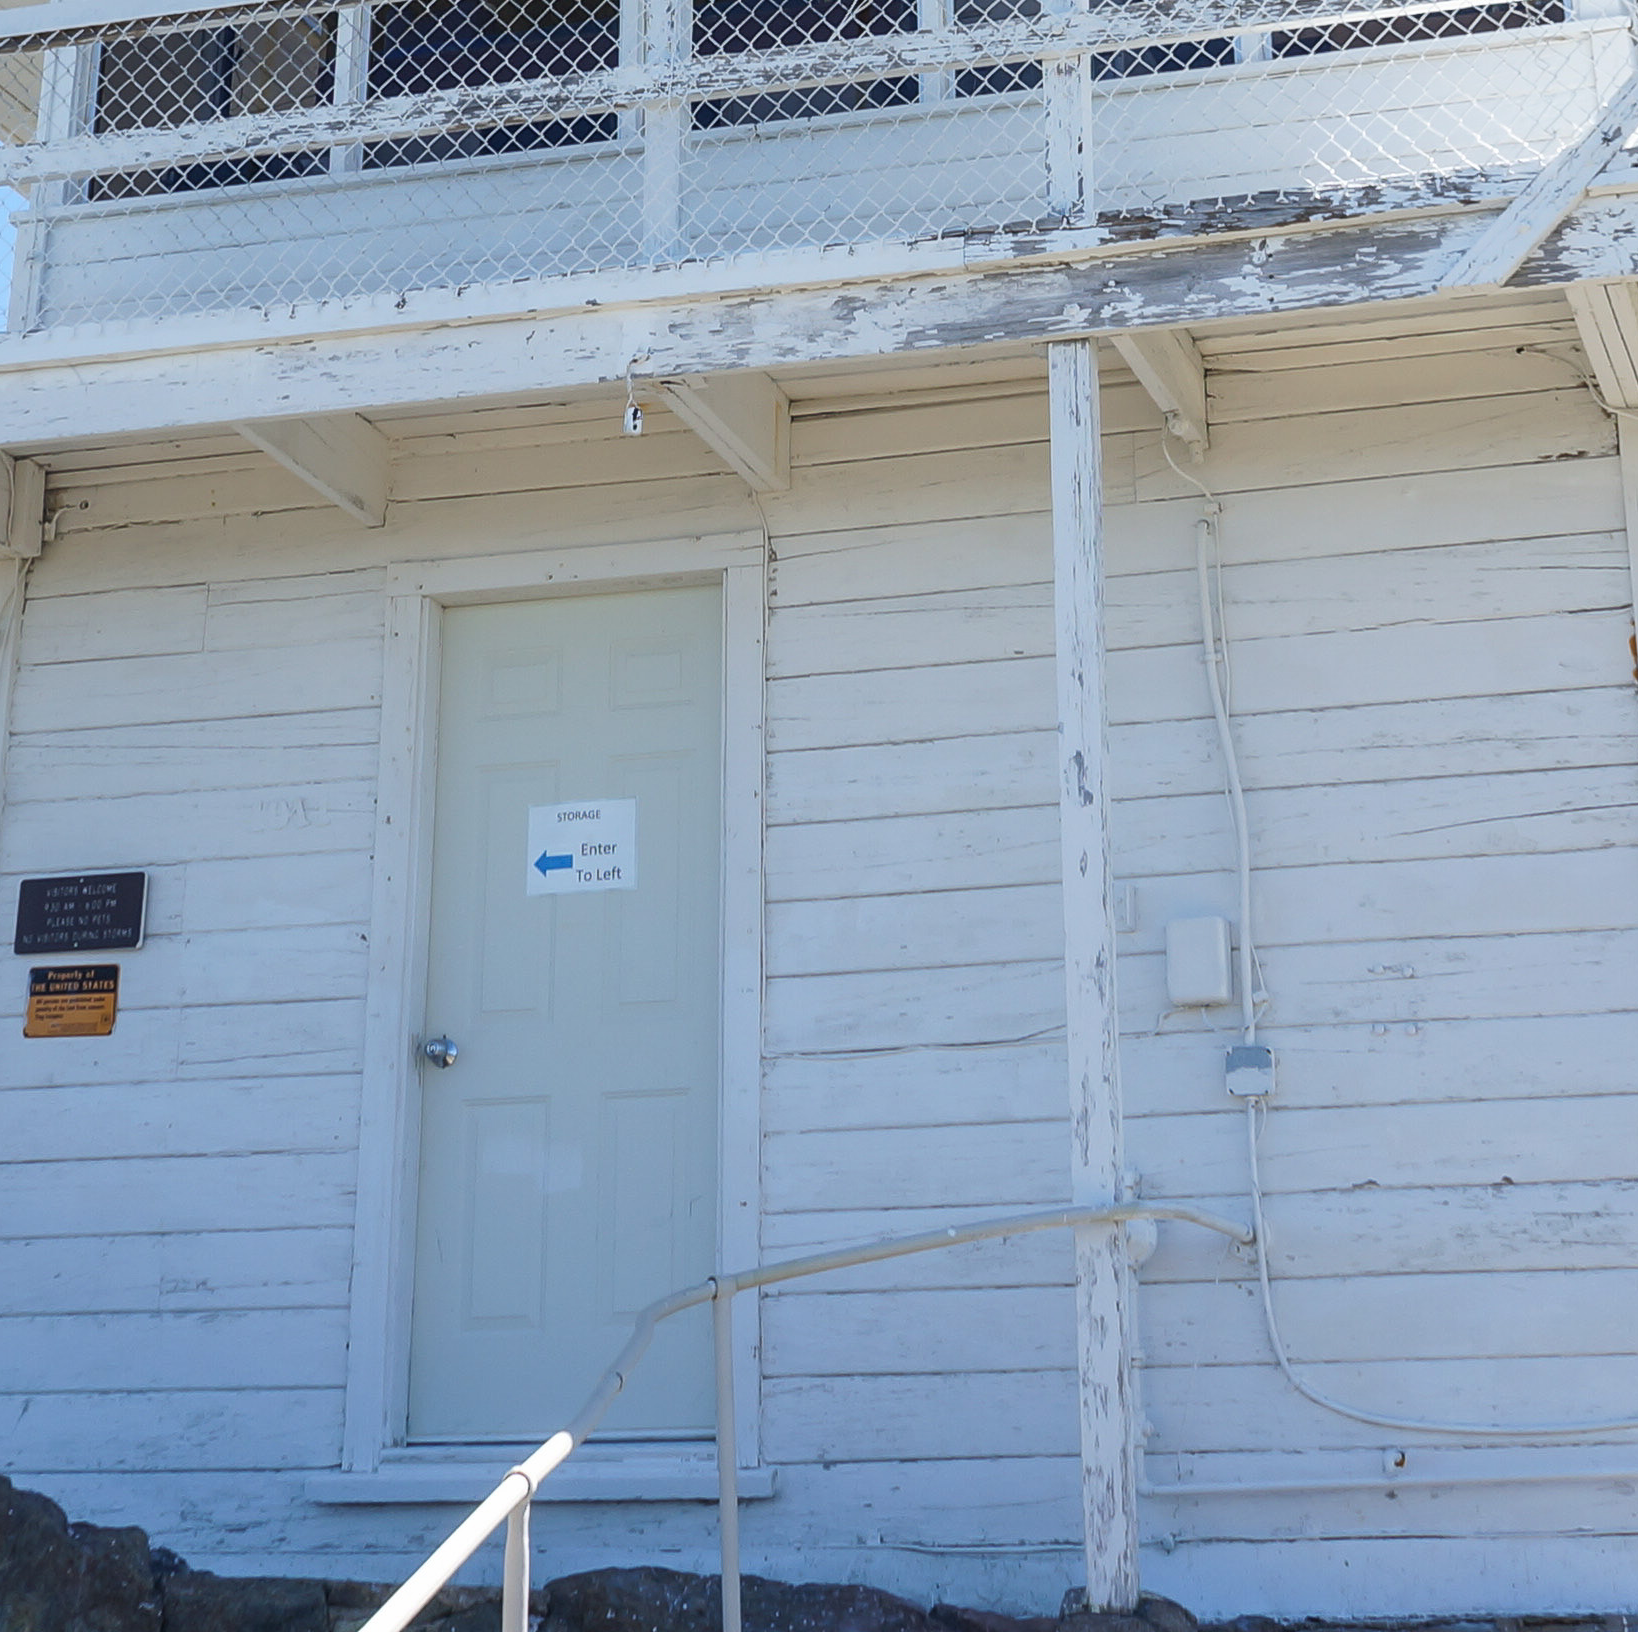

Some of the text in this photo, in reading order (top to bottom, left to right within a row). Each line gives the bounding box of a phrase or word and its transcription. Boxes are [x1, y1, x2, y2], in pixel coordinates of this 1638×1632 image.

[557, 810, 601, 822] STORAGE
[581, 843, 618, 856] Enter
[576, 866, 622, 882] To Left
[47, 882, 118, 897] VISITORS WELCOME
[46, 918, 74, 928] PLEASE
[48, 970, 94, 980] Property of
[32, 980, 114, 992] THE UNITED STATES
